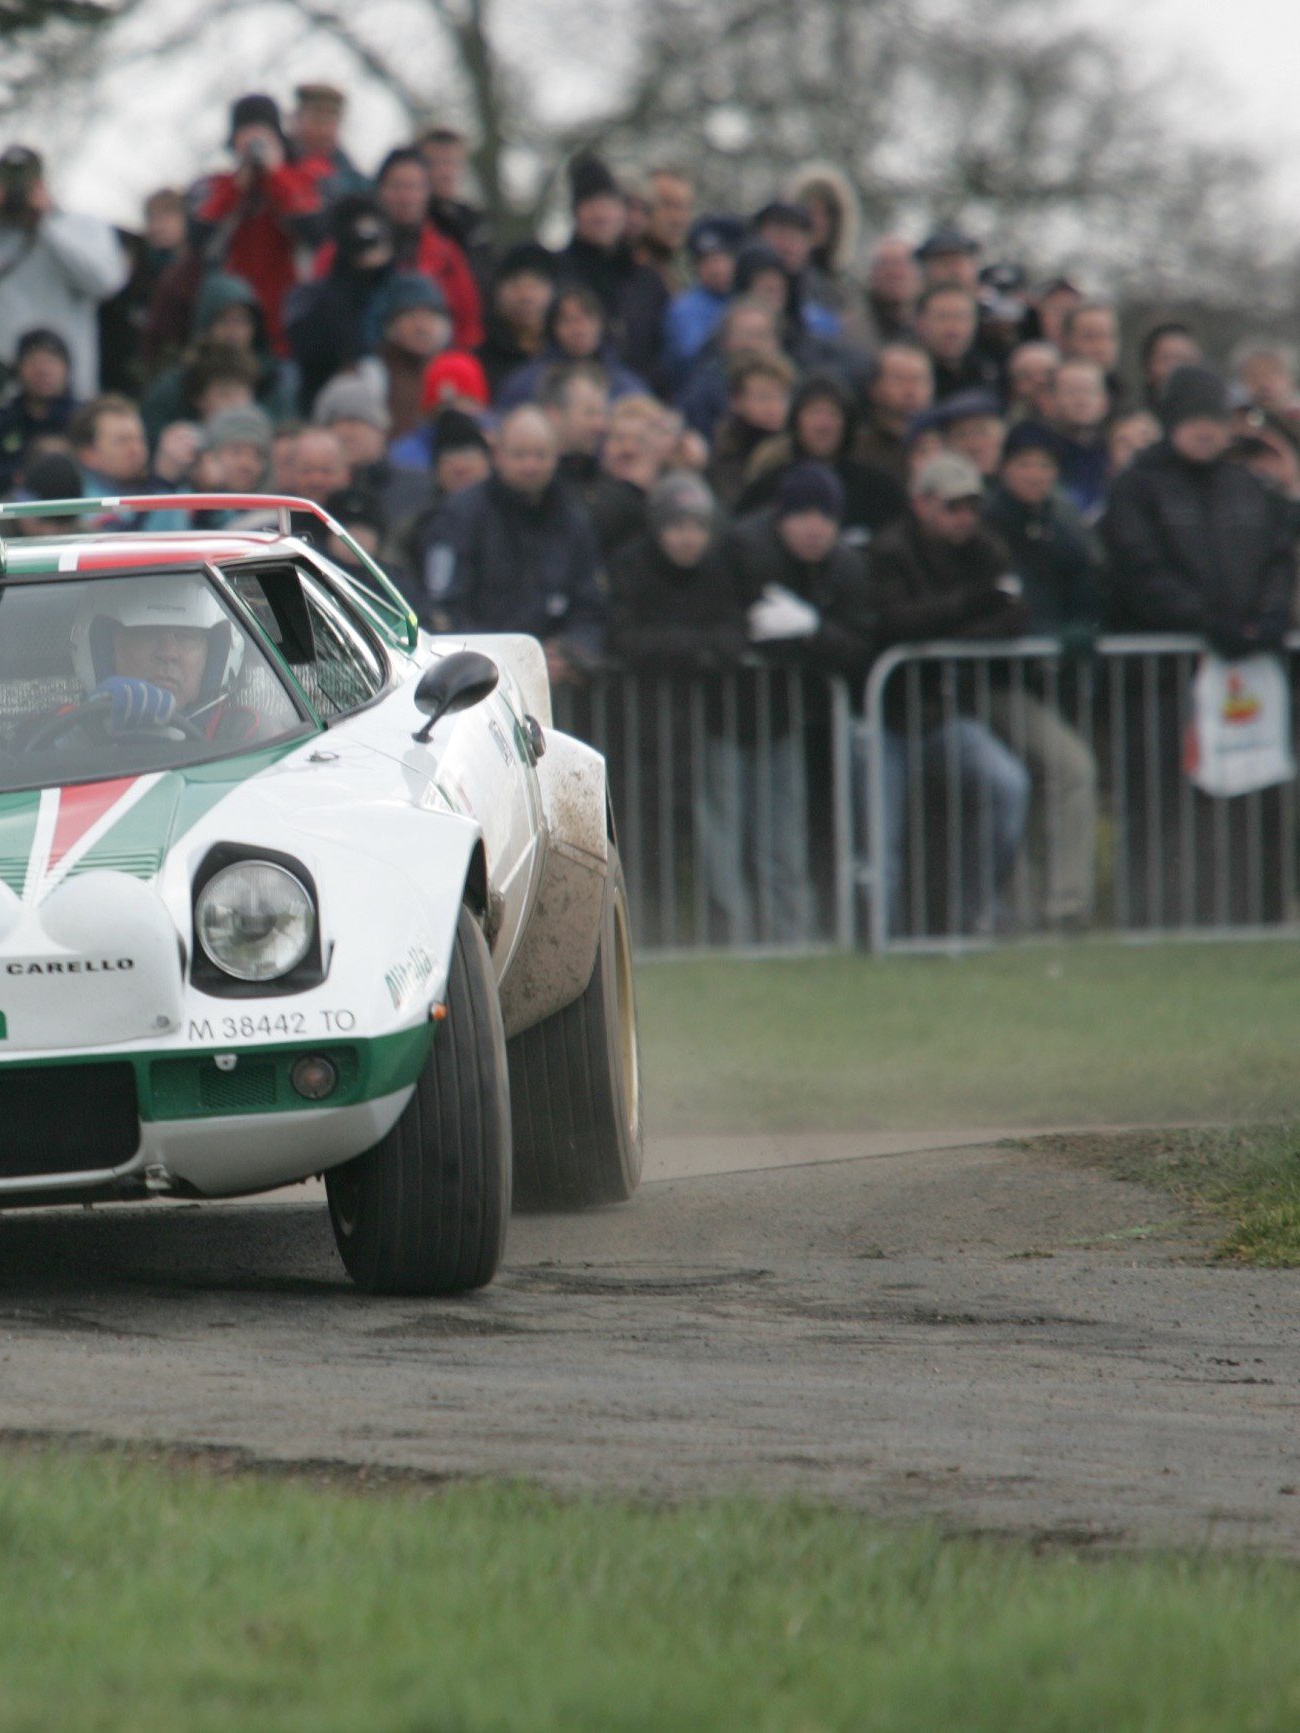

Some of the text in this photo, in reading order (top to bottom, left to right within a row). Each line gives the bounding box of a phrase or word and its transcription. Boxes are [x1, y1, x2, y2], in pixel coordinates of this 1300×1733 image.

[6, 957, 135, 976] CARELLO
[187, 1009, 356, 1041] M 38442 TO
